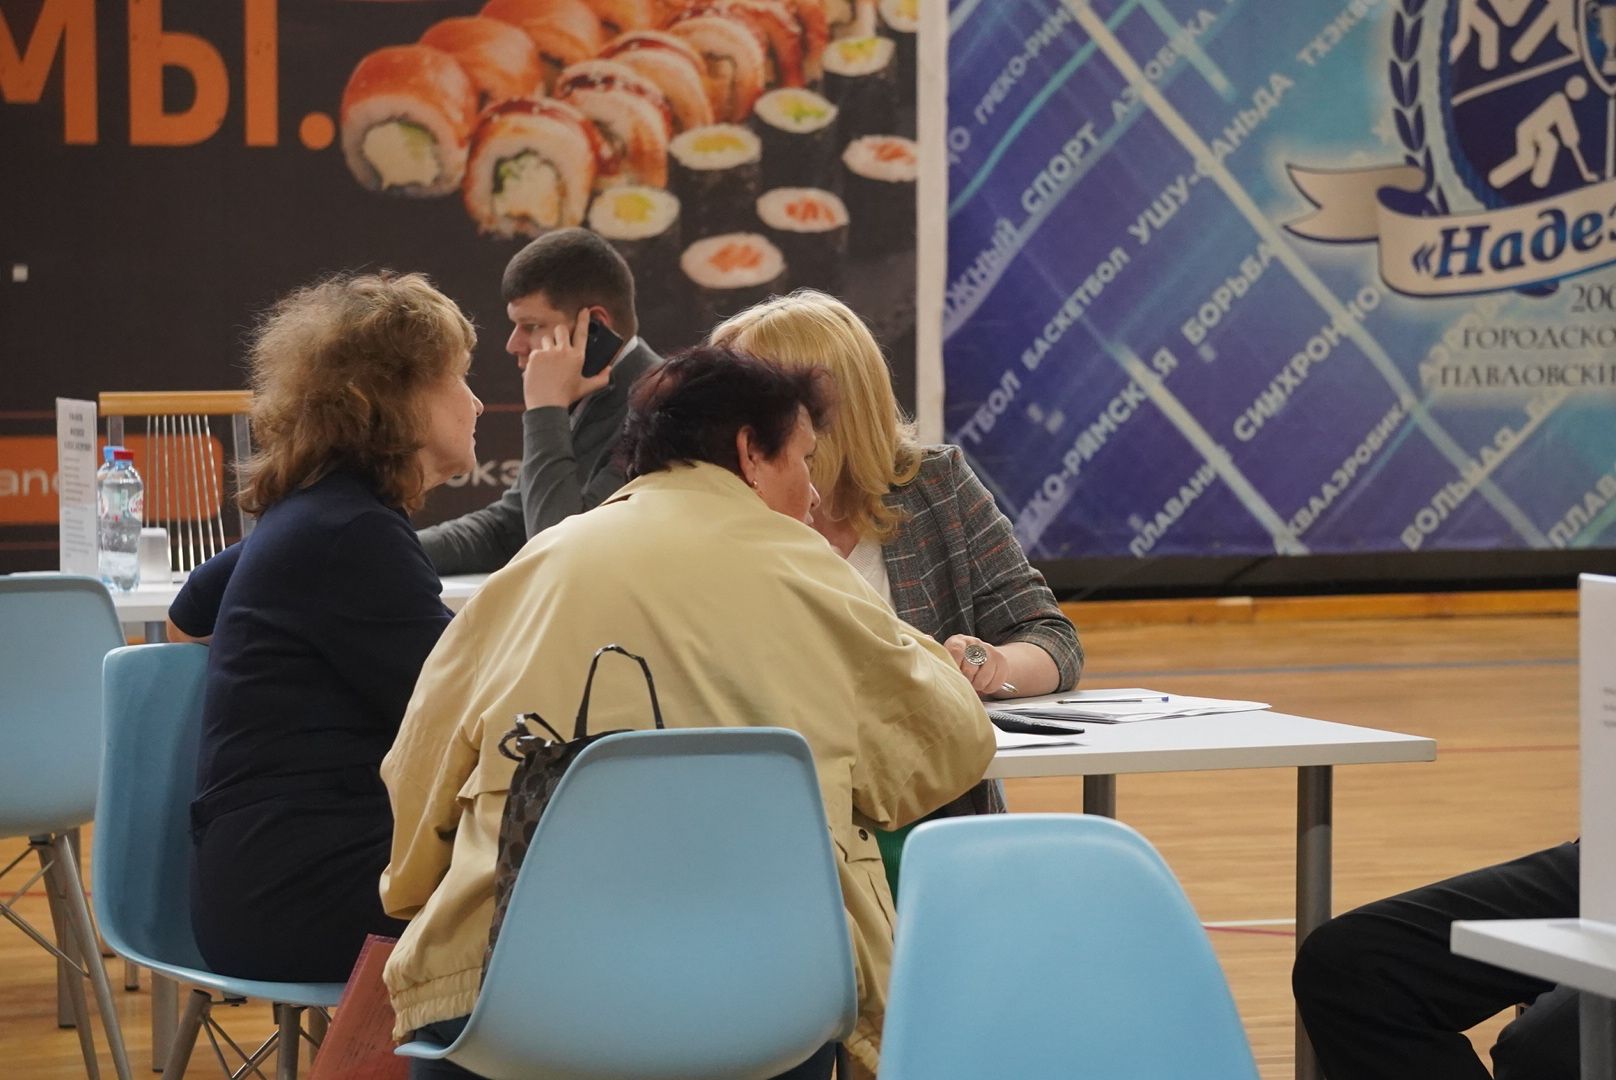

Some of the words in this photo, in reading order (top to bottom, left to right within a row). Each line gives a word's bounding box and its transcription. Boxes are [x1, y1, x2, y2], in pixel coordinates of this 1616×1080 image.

[1021, 121, 1099, 215] СПОРТ
[953, 368, 1021, 446] ТБОЛ
[1021, 246, 1131, 371] БАСКЕТБОЛ
